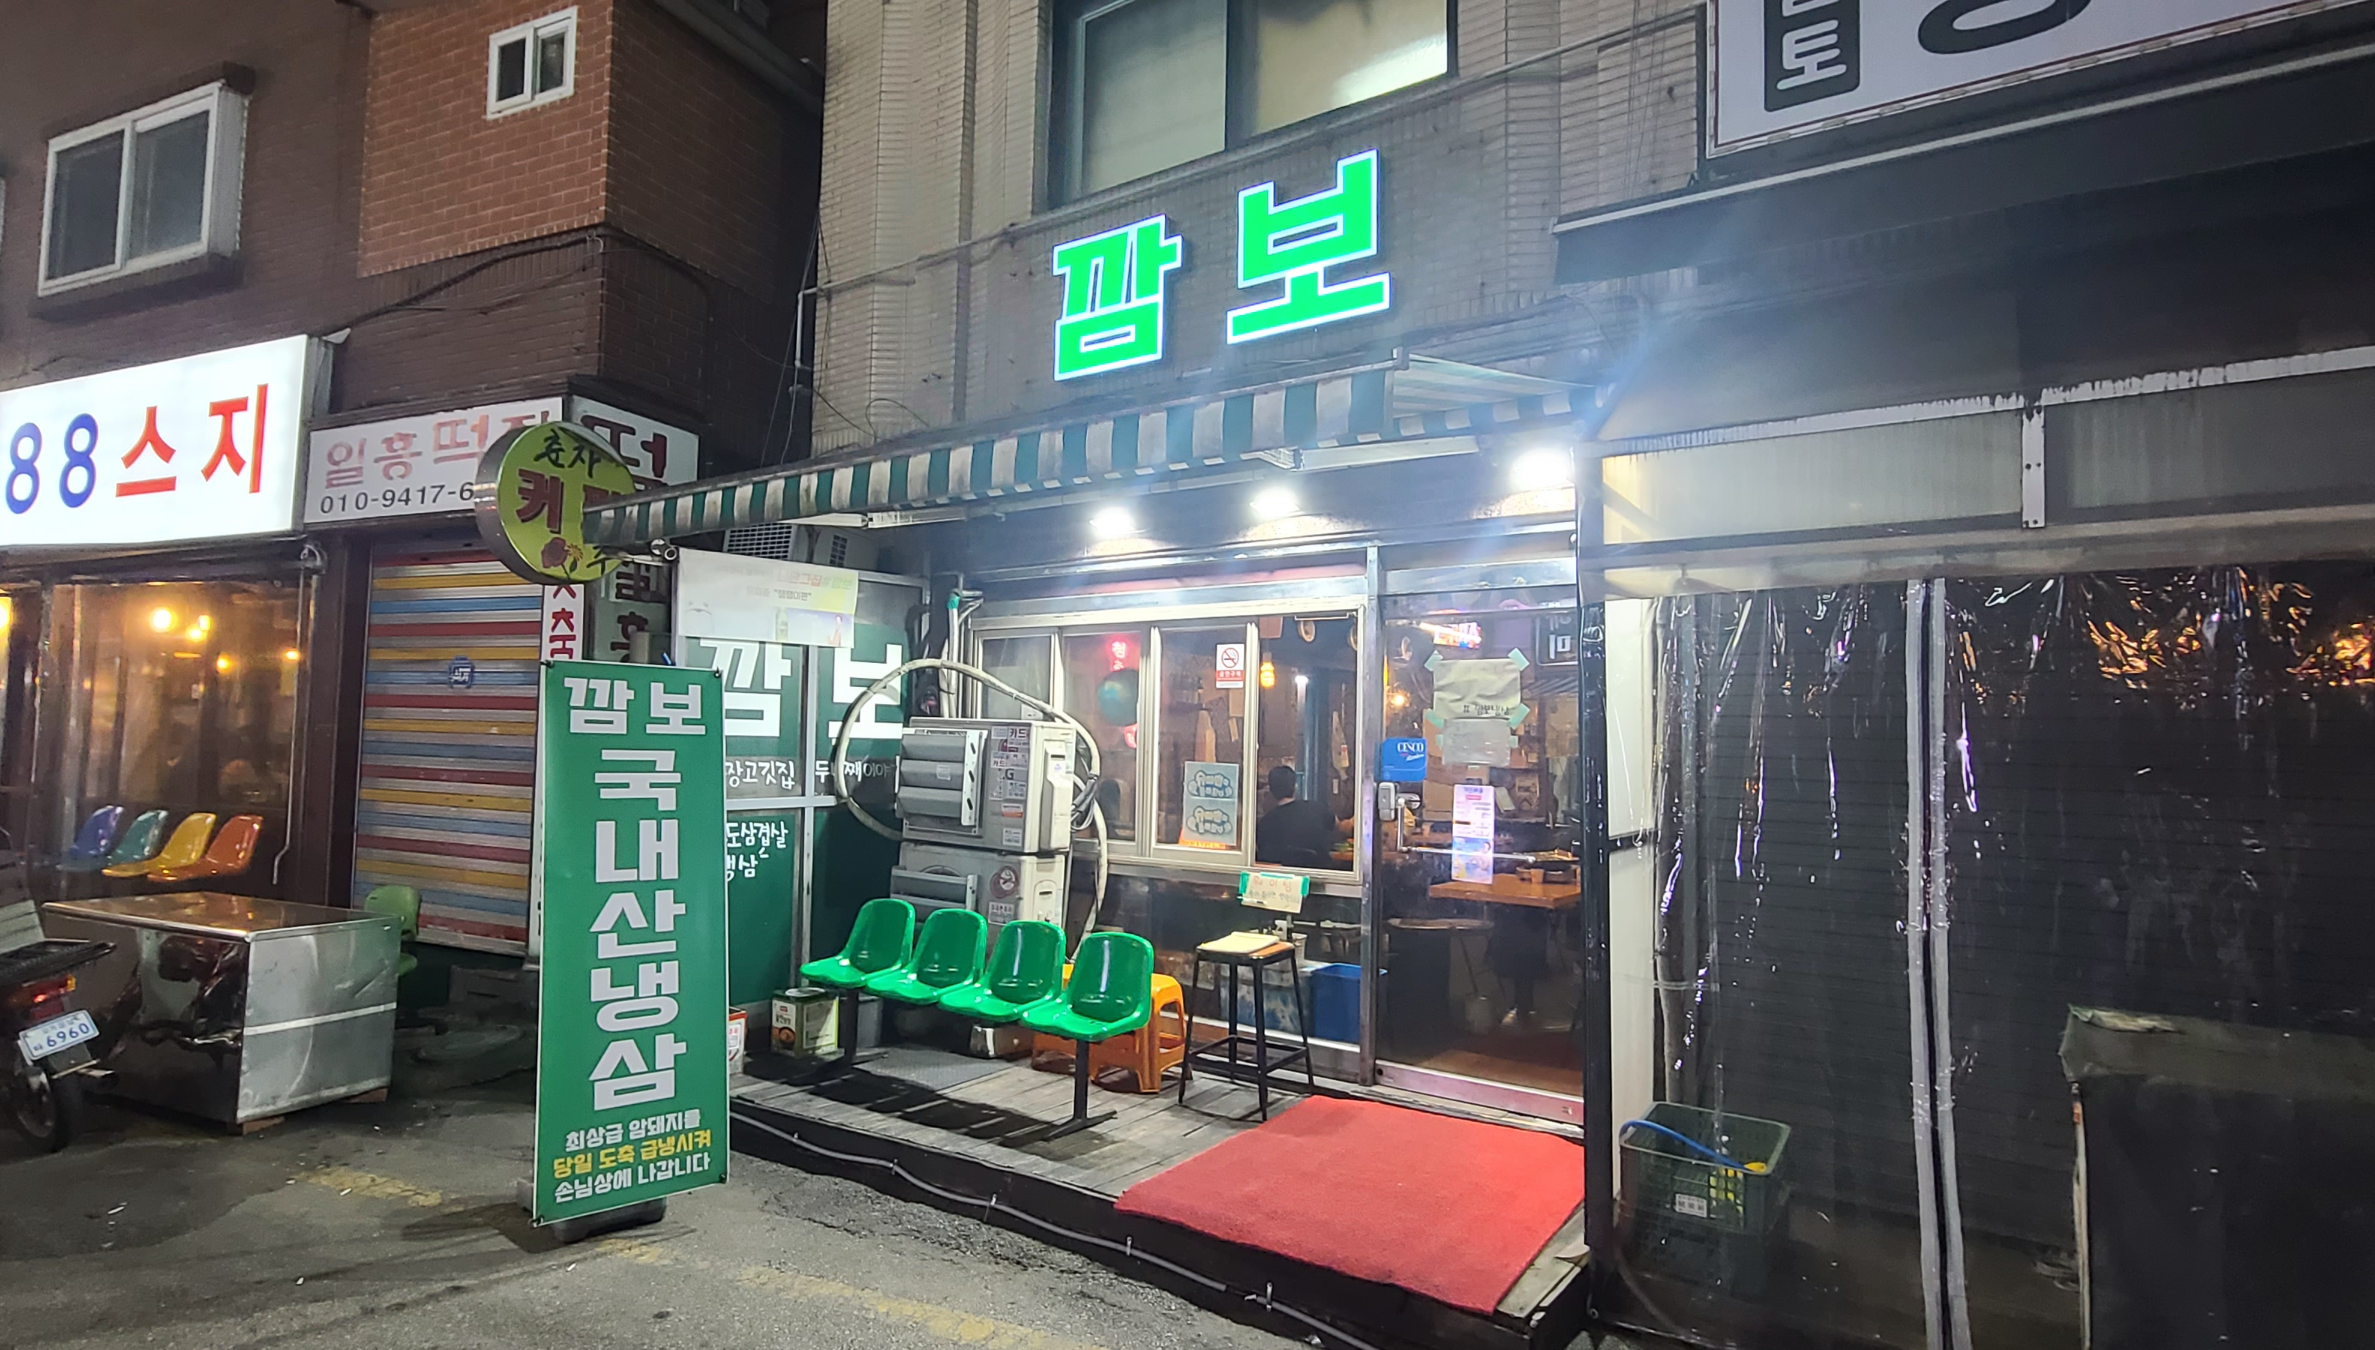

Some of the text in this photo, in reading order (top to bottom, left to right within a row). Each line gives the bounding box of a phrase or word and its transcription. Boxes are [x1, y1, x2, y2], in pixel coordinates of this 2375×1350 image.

[46, 1022, 90, 1048] 6960
[565, 1122, 624, 1152] 최상급
[553, 1152, 593, 1179] 당일
[598, 1144, 635, 1169] 도축
[637, 1151, 711, 1185] 나갑니다
